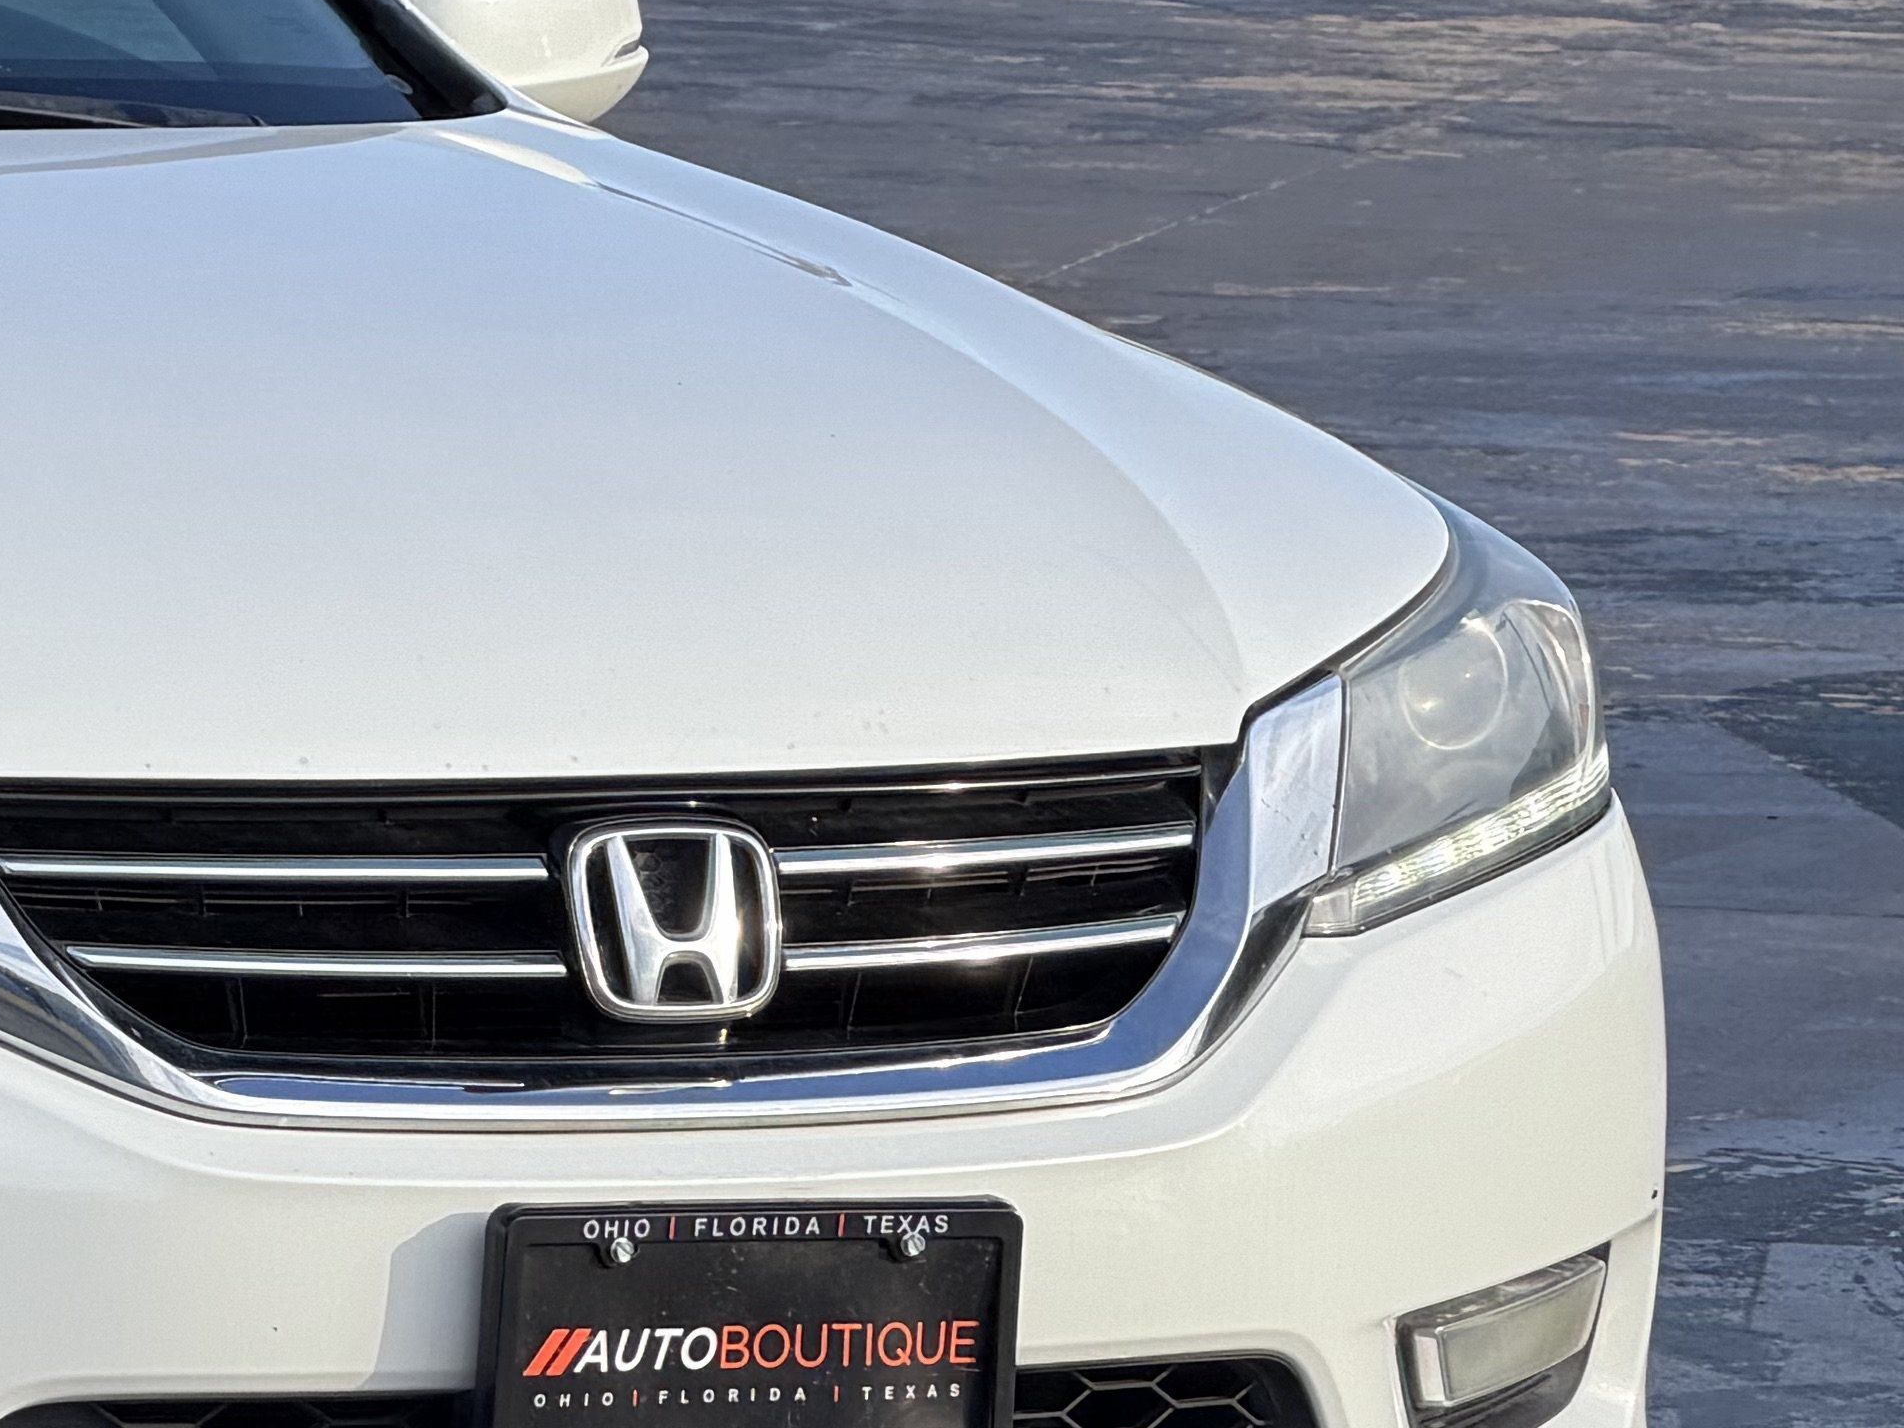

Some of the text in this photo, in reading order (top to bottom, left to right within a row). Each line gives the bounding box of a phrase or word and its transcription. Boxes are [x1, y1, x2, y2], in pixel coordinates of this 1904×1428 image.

[582, 1213, 950, 1239] OHIO FLORIDA TEXAS
[575, 1321, 980, 1372] AUTOBOUTIQUE
[533, 1384, 962, 1408] OHIO FLORIDA TEXAS
